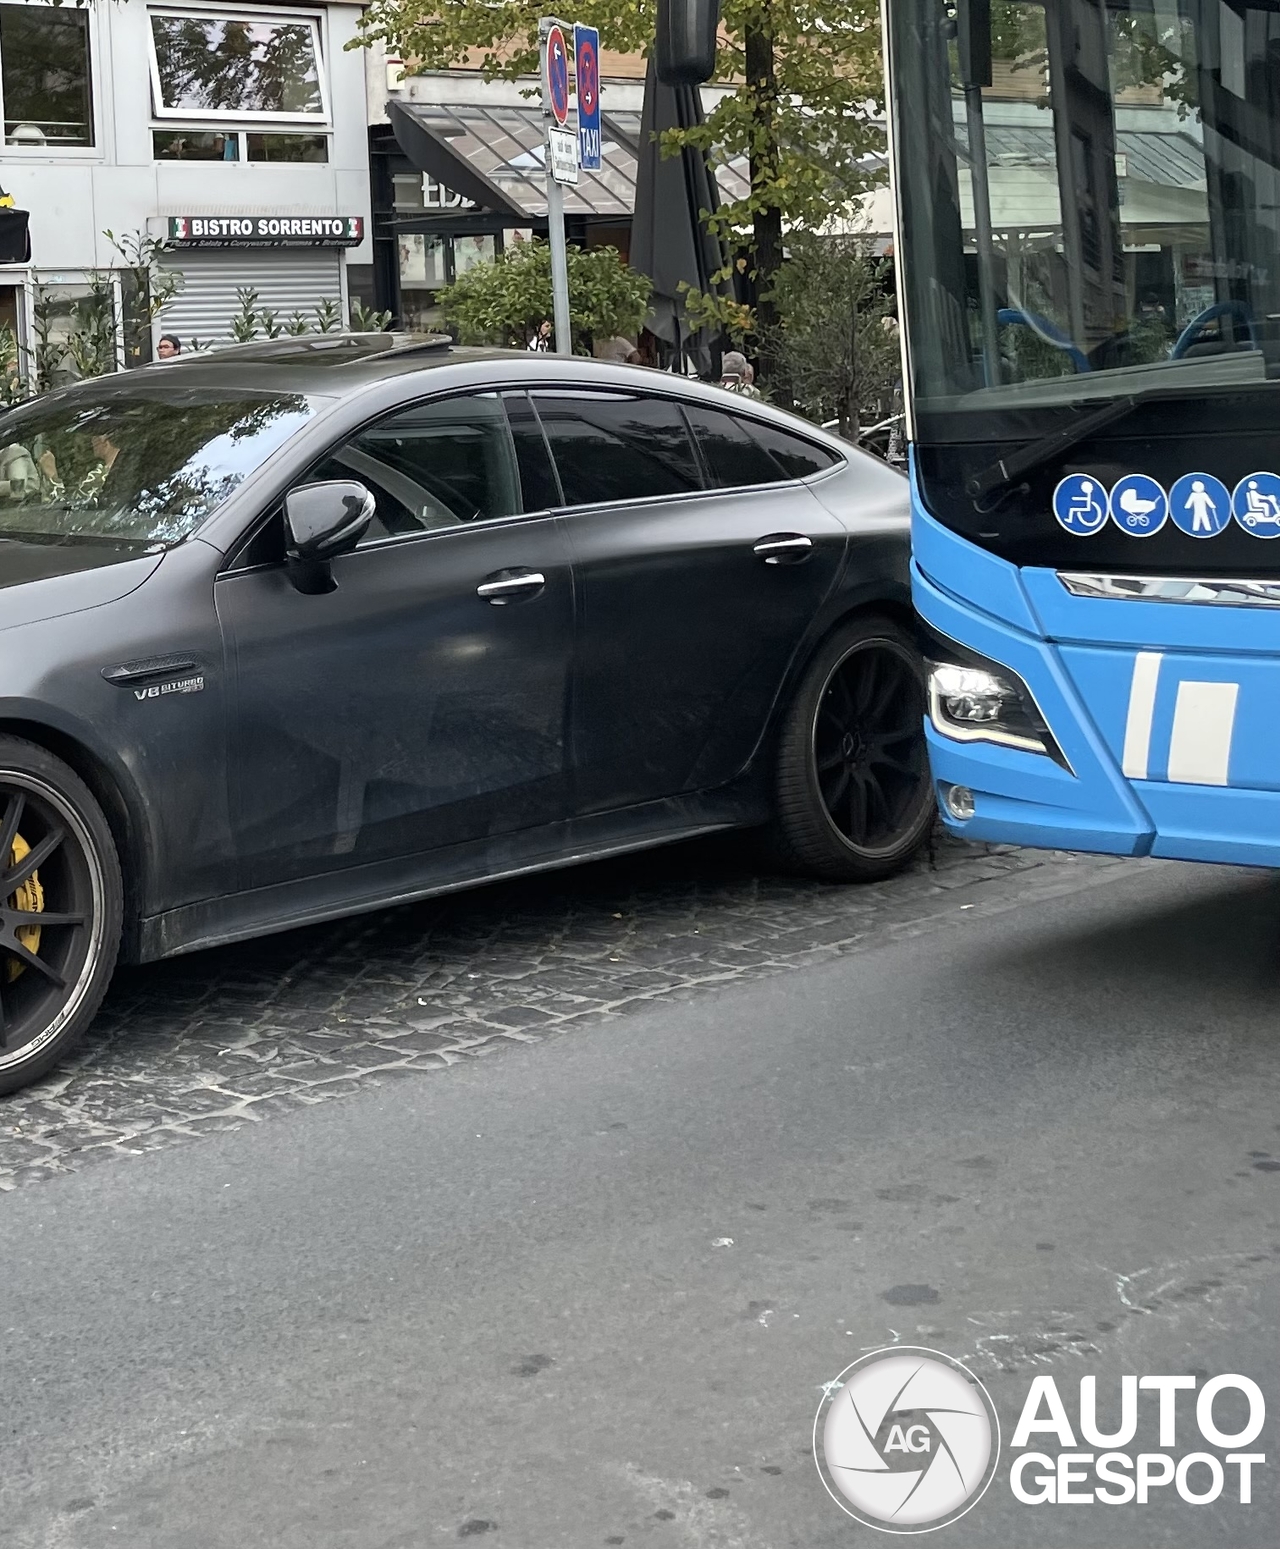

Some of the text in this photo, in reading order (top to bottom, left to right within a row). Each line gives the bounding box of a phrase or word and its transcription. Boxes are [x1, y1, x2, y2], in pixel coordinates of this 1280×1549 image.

[580, 128, 599, 158] TAXI
[191, 219, 343, 236] BISTRO SORRENTO
[134, 686, 160, 701] V8
